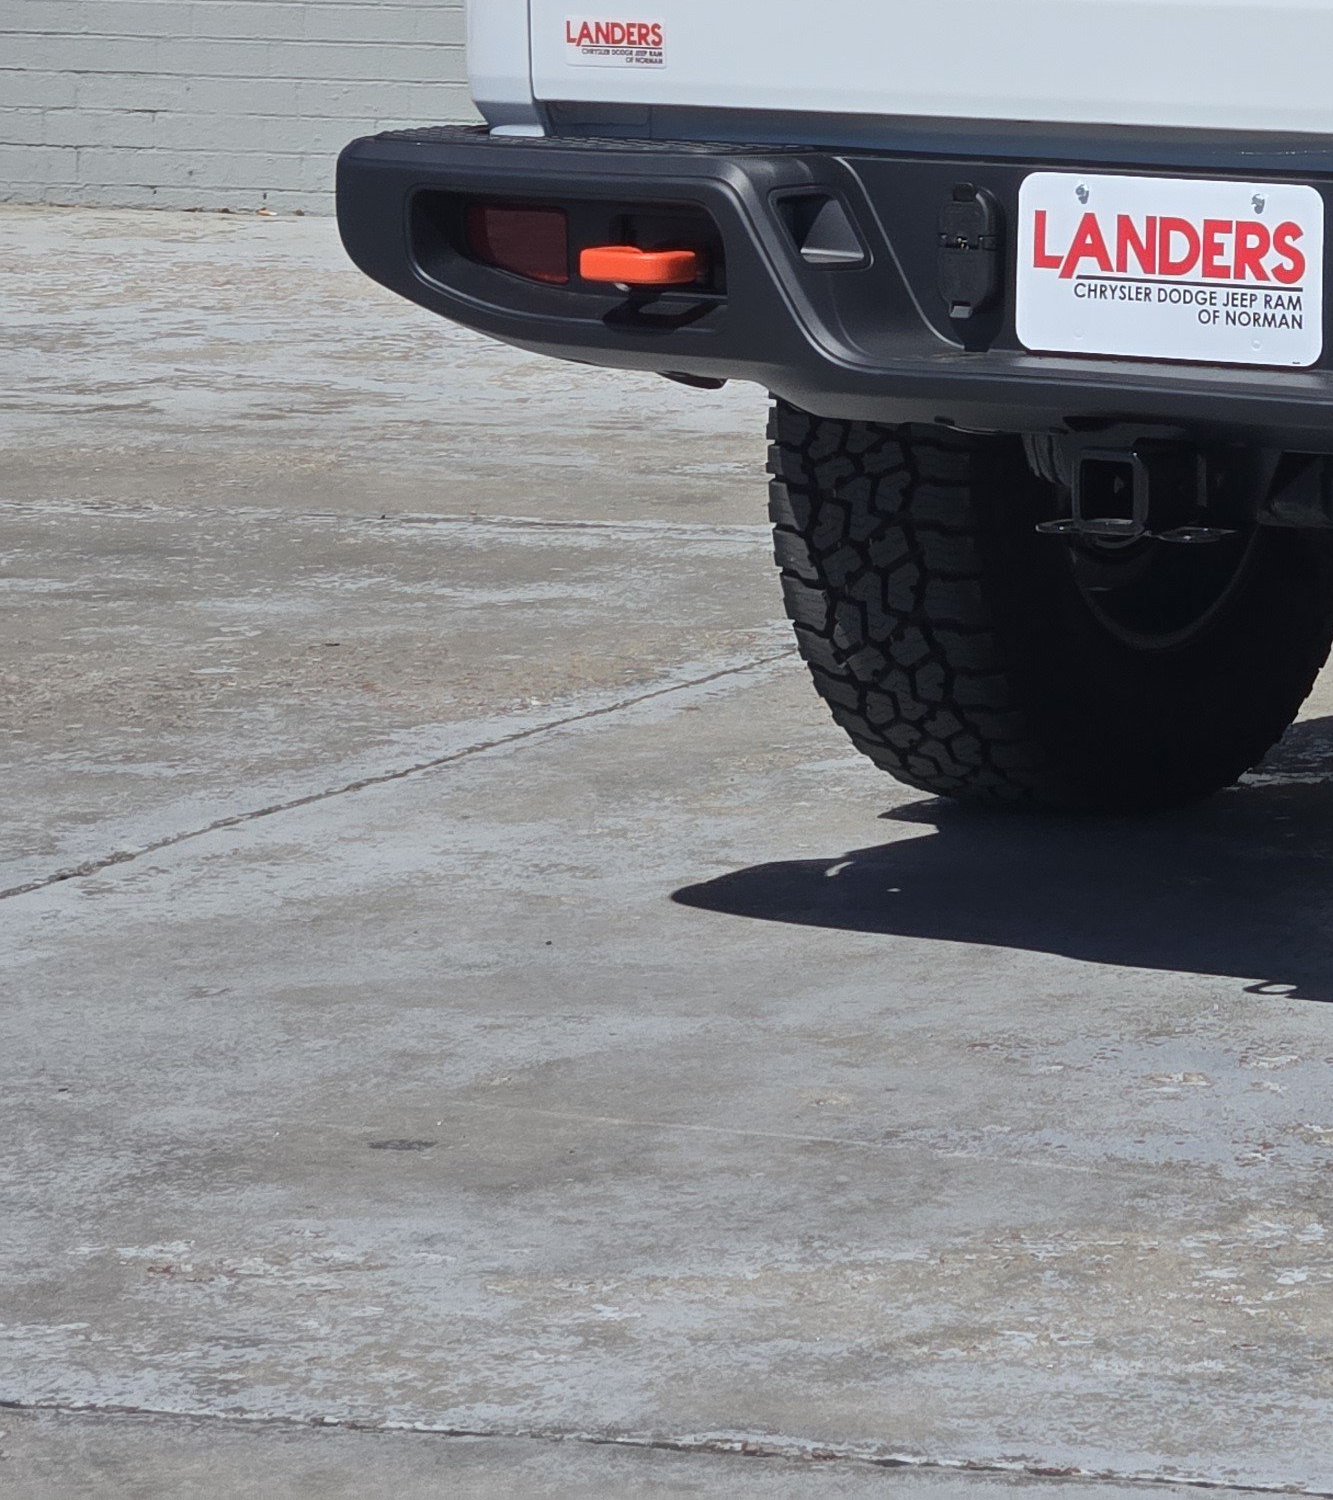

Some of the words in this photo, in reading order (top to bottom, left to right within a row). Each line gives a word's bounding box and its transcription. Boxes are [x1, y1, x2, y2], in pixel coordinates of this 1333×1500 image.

[566, 20, 663, 46] LANDERS
[1033, 210, 1306, 284] LANDERS
[1074, 283, 1152, 303] CHRYSLER
[1157, 288, 1217, 306] DODGE
[1222, 292, 1258, 308] JEEP
[1264, 295, 1302, 311] RAM
[1198, 309, 1219, 325] OF
[1225, 310, 1303, 330] NORMAN
